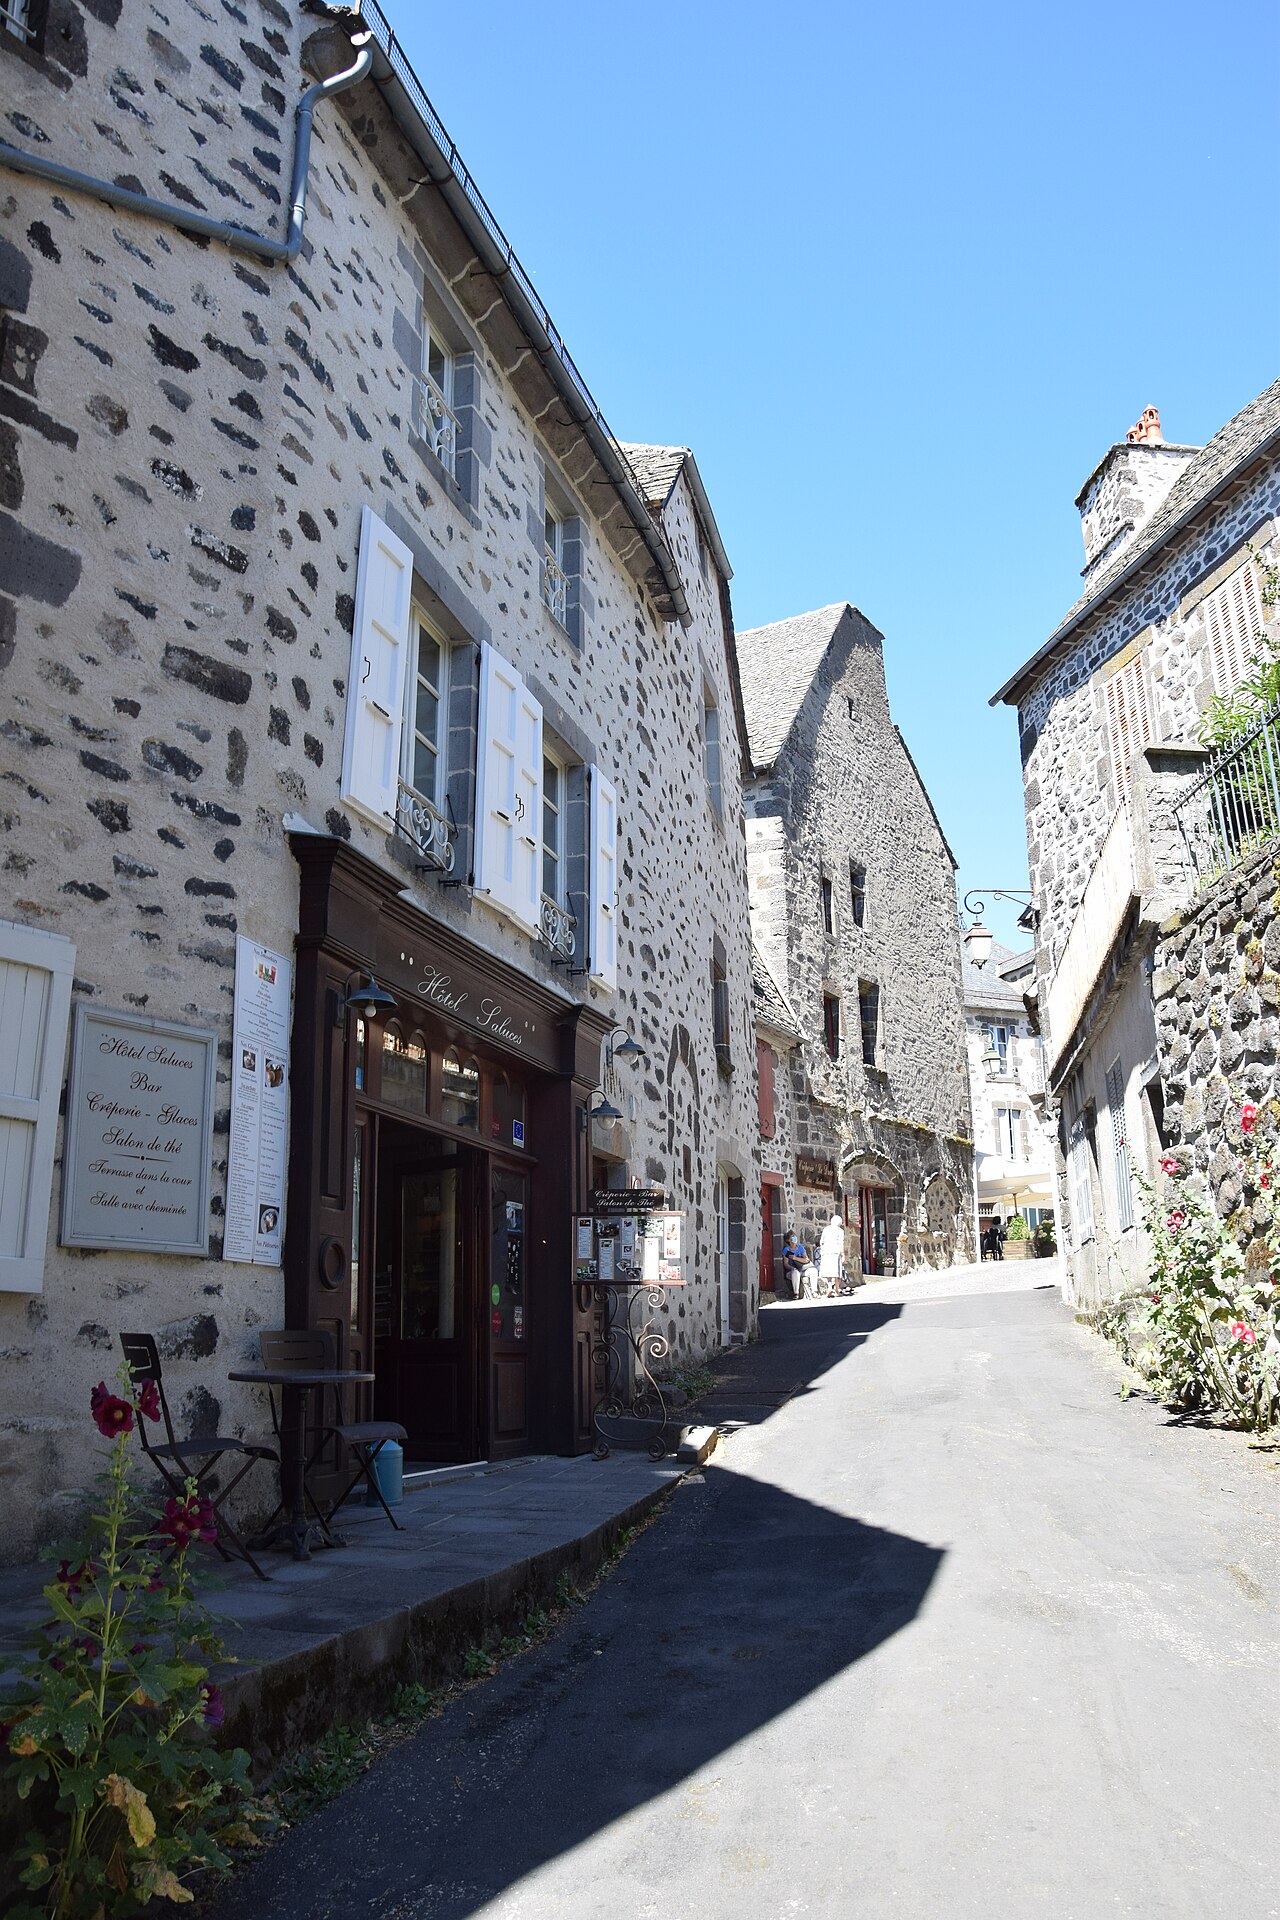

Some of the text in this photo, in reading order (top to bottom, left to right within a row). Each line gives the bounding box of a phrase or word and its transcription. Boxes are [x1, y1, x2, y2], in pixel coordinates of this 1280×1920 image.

[417, 965, 522, 1045] Hôtel Saluces
[99, 1037, 193, 1069] Hôtel Saluces
[130, 1071, 162, 1092] Bar
[86, 1091, 141, 1119] Crêperie
[156, 1103, 198, 1126] Glaces
[101, 1126, 183, 1154] Salon de thé
[88, 1160, 193, 1186] Terrasse dans la cour
[89, 1191, 187, 1215] Salle avec cheminée
[135, 1186, 146, 1195] et
[594, 1190, 630, 1200] Crêperie
[638, 1190, 660, 1198] Bar
